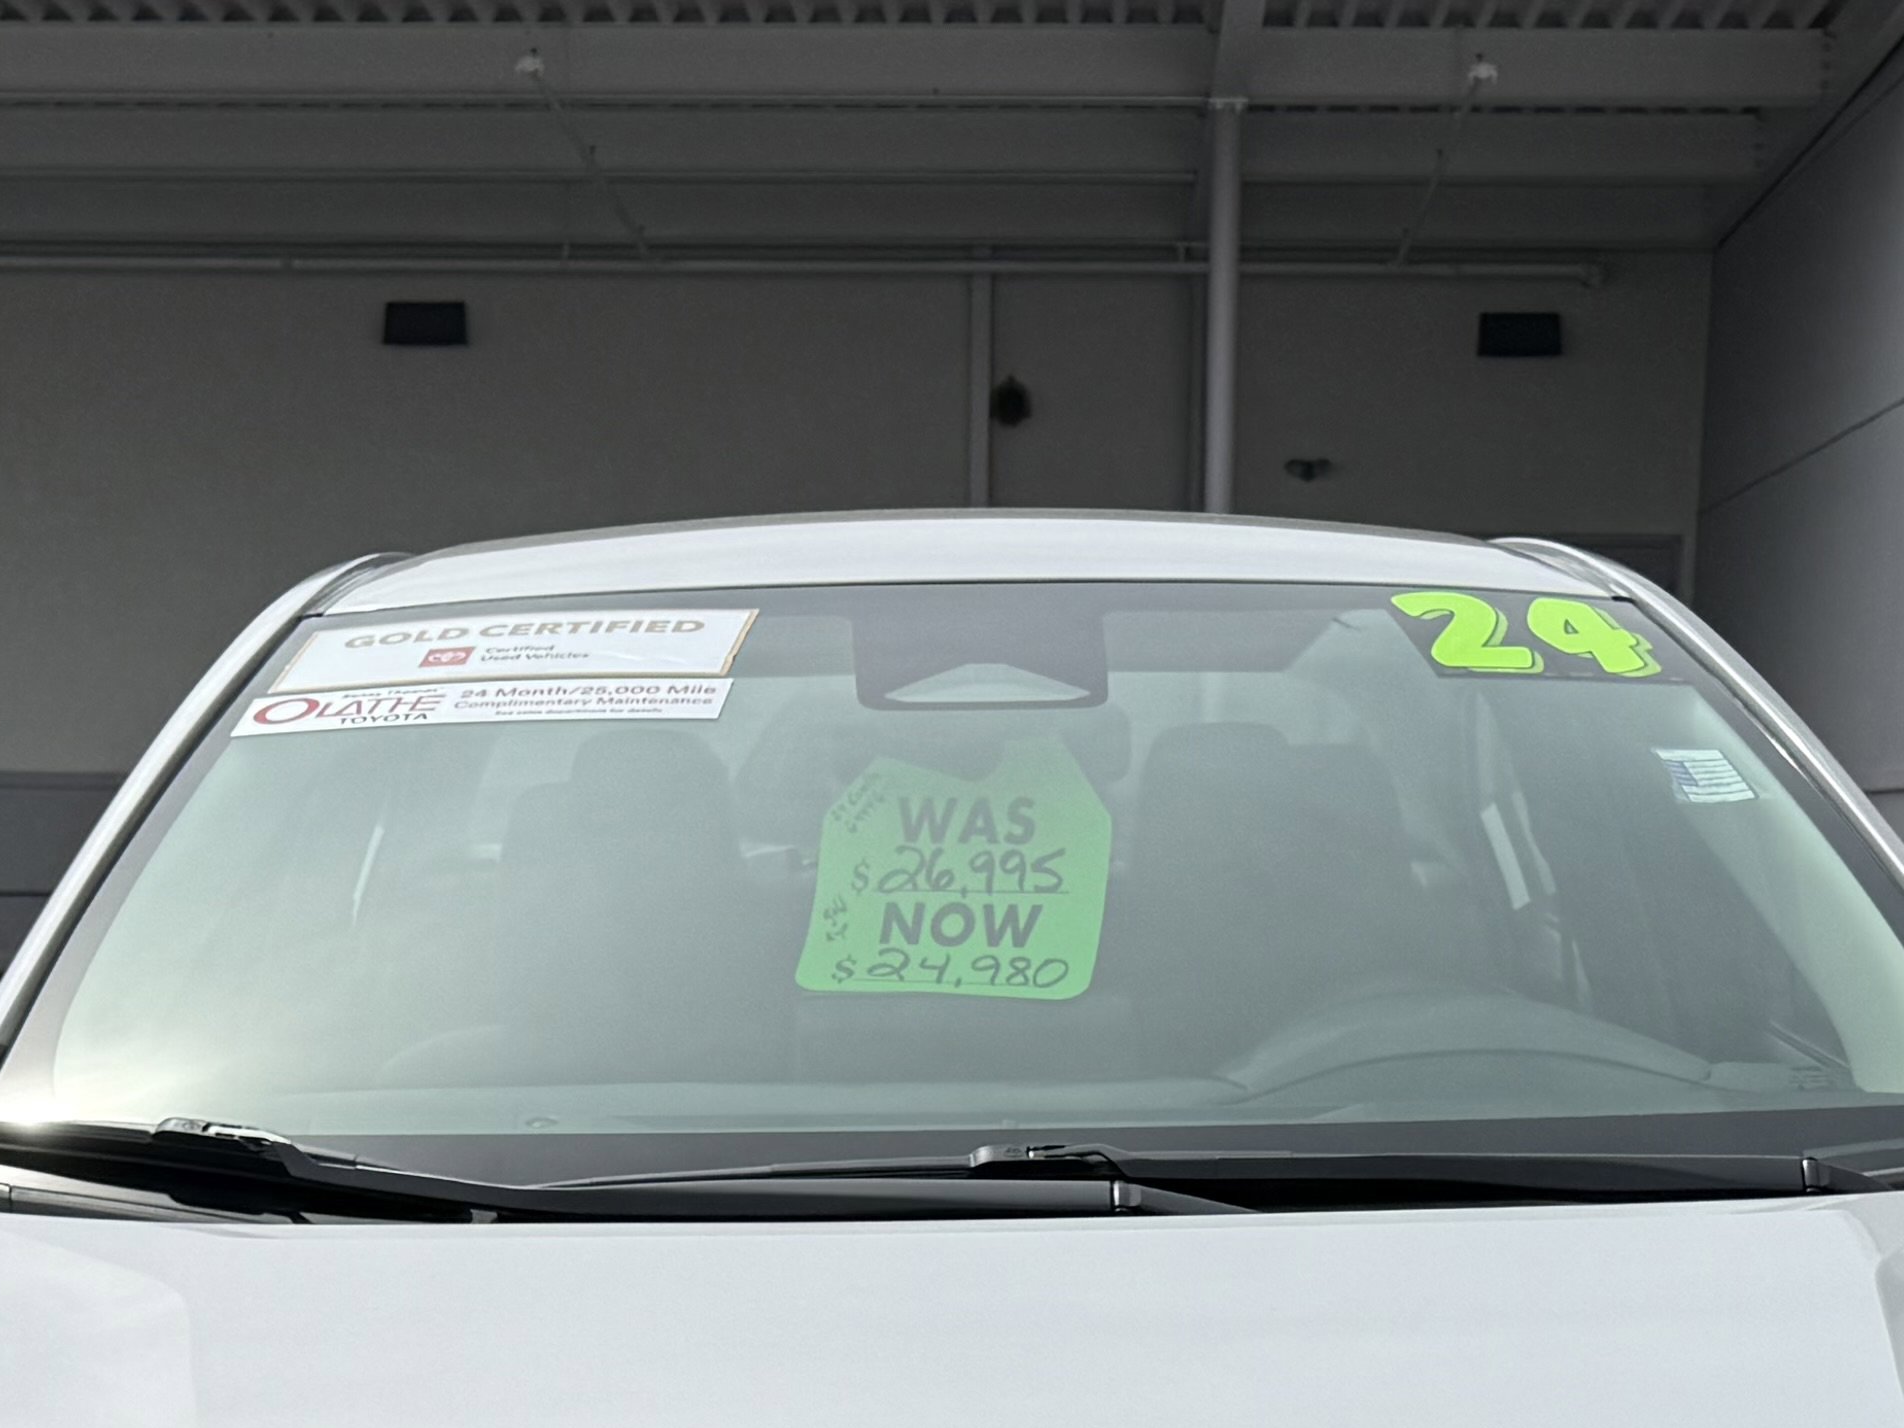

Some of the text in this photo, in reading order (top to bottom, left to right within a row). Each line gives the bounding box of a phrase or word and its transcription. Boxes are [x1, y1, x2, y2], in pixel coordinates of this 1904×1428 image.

[345, 620, 705, 649] GOLD CERTIFIED
[1391, 591, 1662, 678] 24
[480, 651, 590, 662] Used Vehicles
[460, 688, 487, 699] 24
[667, 685, 717, 695] Mile
[454, 696, 713, 710] Complimentary Maintenance
[340, 713, 428, 725] TOYOTA
[899, 797, 1036, 845] WAS
[879, 901, 1044, 949] NOW
